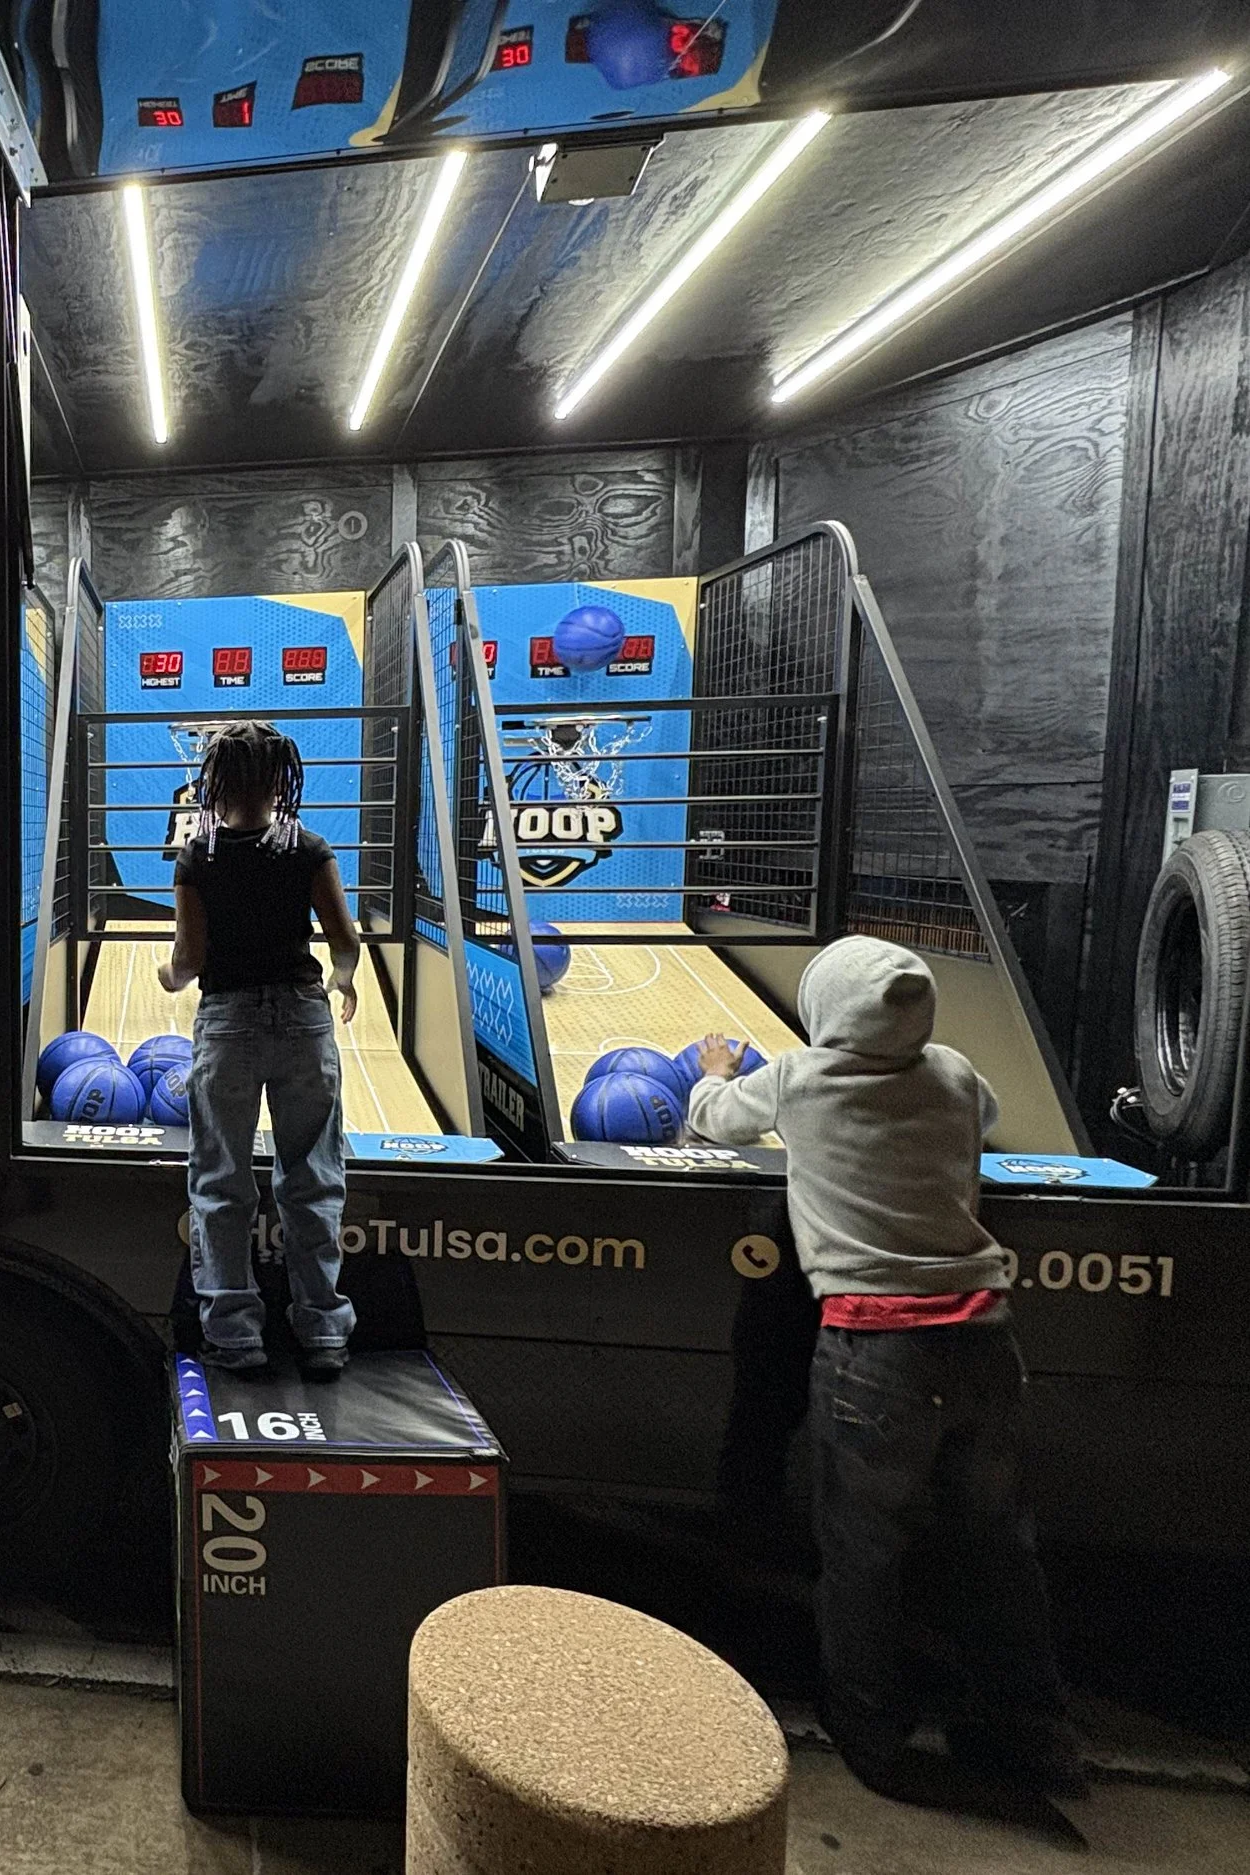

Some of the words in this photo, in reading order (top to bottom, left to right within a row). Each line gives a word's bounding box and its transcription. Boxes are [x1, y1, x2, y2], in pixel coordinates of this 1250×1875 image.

[537, 666, 566, 677] TIME
[608, 662, 650, 674] SCORE
[141, 676, 181, 687] HIGHEST
[220, 676, 245, 686] TIME
[285, 672, 323, 683] SCORE
[64, 1124, 166, 1137] HOOP
[62, 1134, 163, 1146] TULSA
[619, 1145, 740, 1160] HOOP
[633, 1156, 761, 1170] TULSA
[217, 1411, 301, 1441] 16
[297, 1412, 327, 1442] INCH
[201, 1493, 267, 1573] 20
[202, 1574, 267, 1596] INCH
